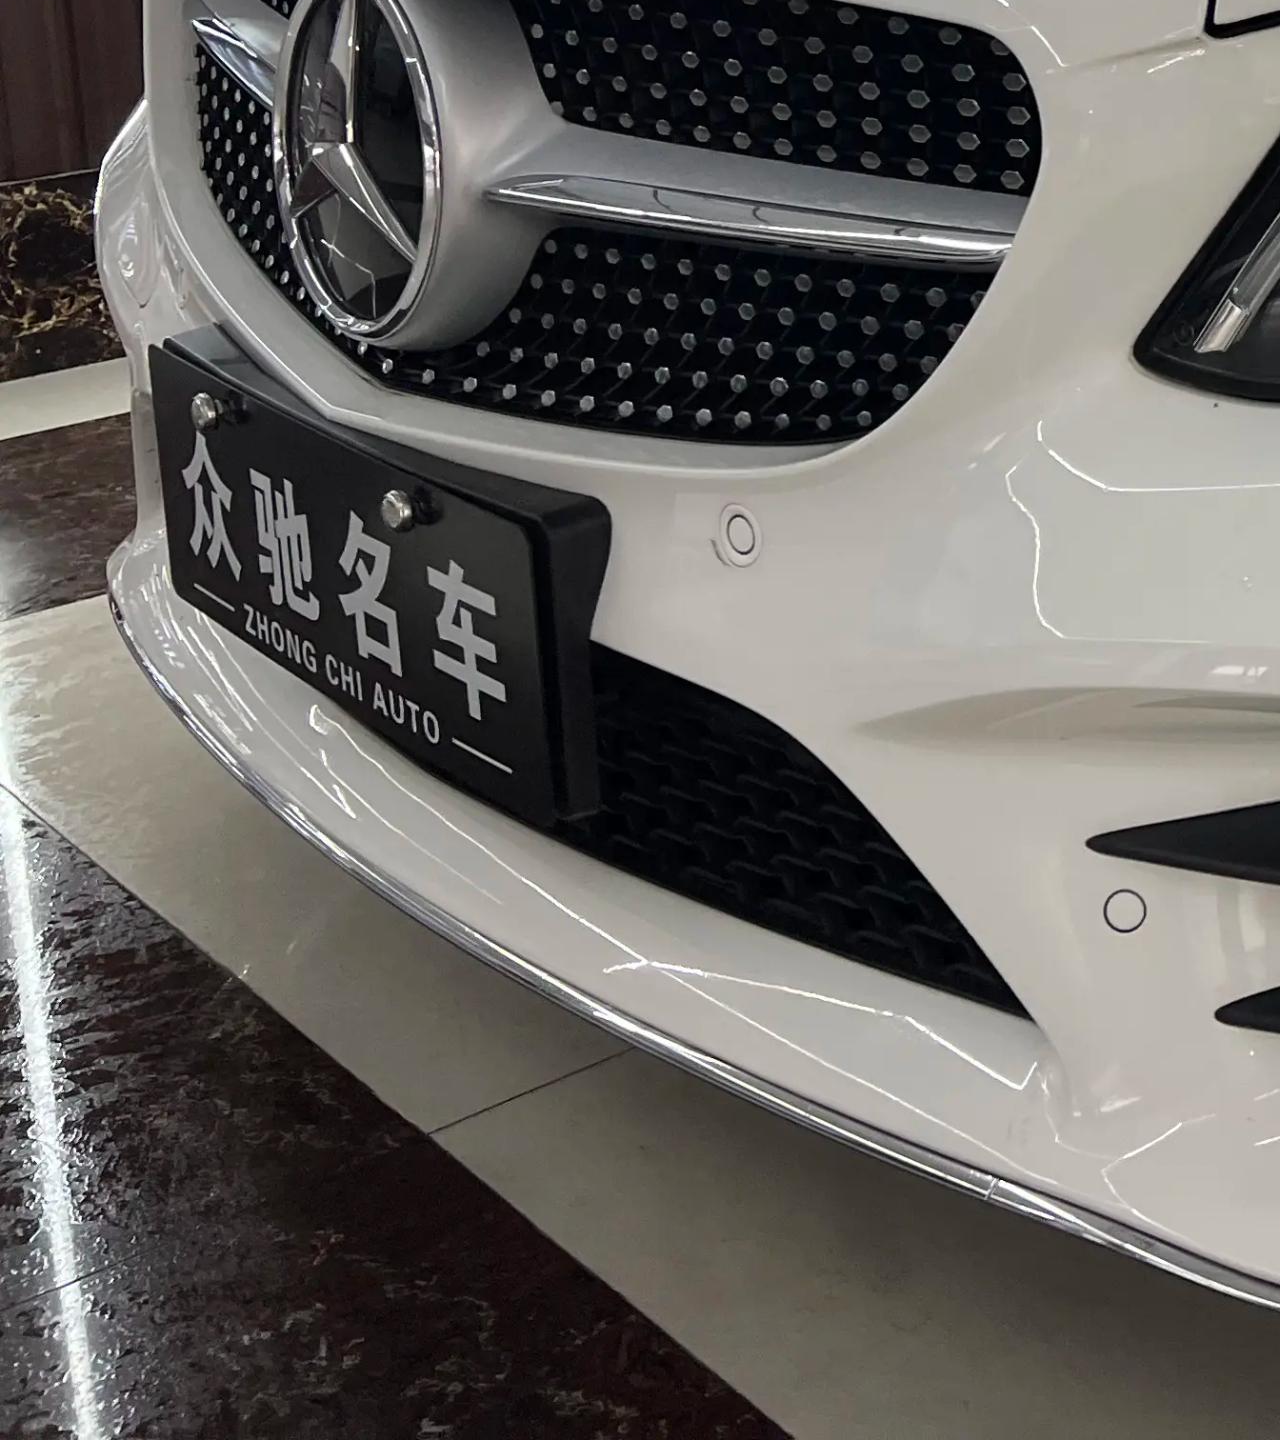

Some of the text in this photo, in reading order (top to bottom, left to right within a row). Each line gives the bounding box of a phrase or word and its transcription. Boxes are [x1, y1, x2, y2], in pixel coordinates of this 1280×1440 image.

[180, 431, 509, 722] 众驰名车
[243, 603, 441, 746] ZHONG CHI AUTO
